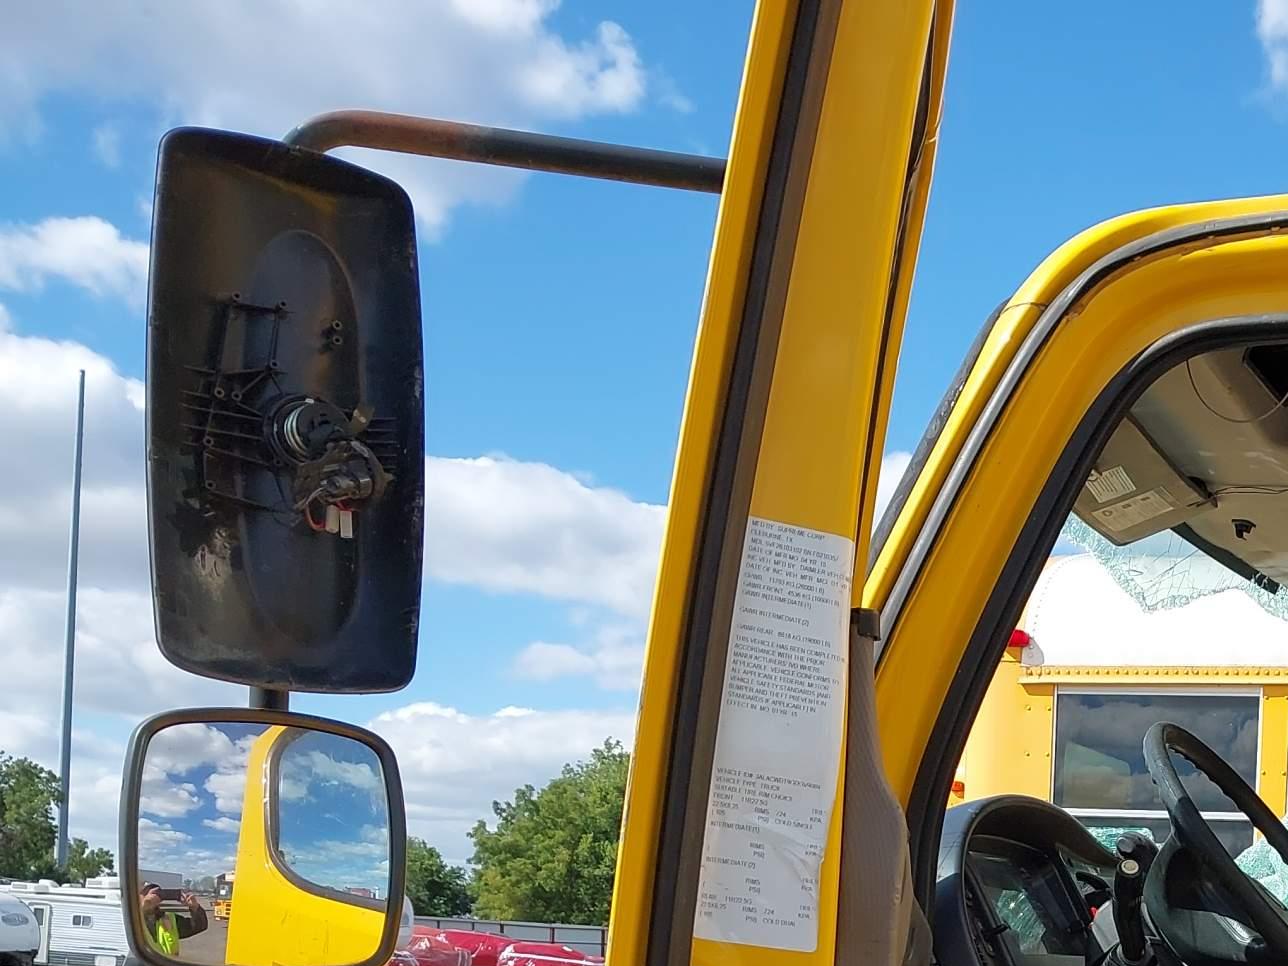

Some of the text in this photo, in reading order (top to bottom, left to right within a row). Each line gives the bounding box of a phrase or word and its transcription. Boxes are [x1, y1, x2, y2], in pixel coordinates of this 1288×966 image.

[748, 545, 762, 553] DATE
[746, 562, 760, 570] DATE
[762, 565, 770, 573] OF
[736, 635, 749, 643] THIS
[751, 638, 774, 648] VEHICLE
[789, 645, 805, 654] BEEN
[734, 643, 775, 656] ACCORDANCE
[777, 651, 792, 660] WITH
[806, 657, 825, 666] PRIOR
[730, 675, 754, 685] VEHICLE
[757, 680, 778, 689] SAFETY
[743, 669, 778, 681] APPLICABLE
[779, 676, 805, 686] FEDERAL
[807, 681, 830, 691] MOTOR
[770, 667, 795, 676] VEHICLE
[796, 671, 831, 683] CONFORMS
[728, 691, 764, 704] STANDARDS
[755, 688, 768, 696] AND
[770, 691, 787, 699] THEFT
[789, 694, 827, 706] PREVENTION
[716, 767, 741, 777] VEHICLE
[715, 775, 740, 785] VEHICLE
[743, 780, 756, 788] TYPE
[760, 782, 780, 792] TRUCK
[713, 792, 733, 801] FRONT
